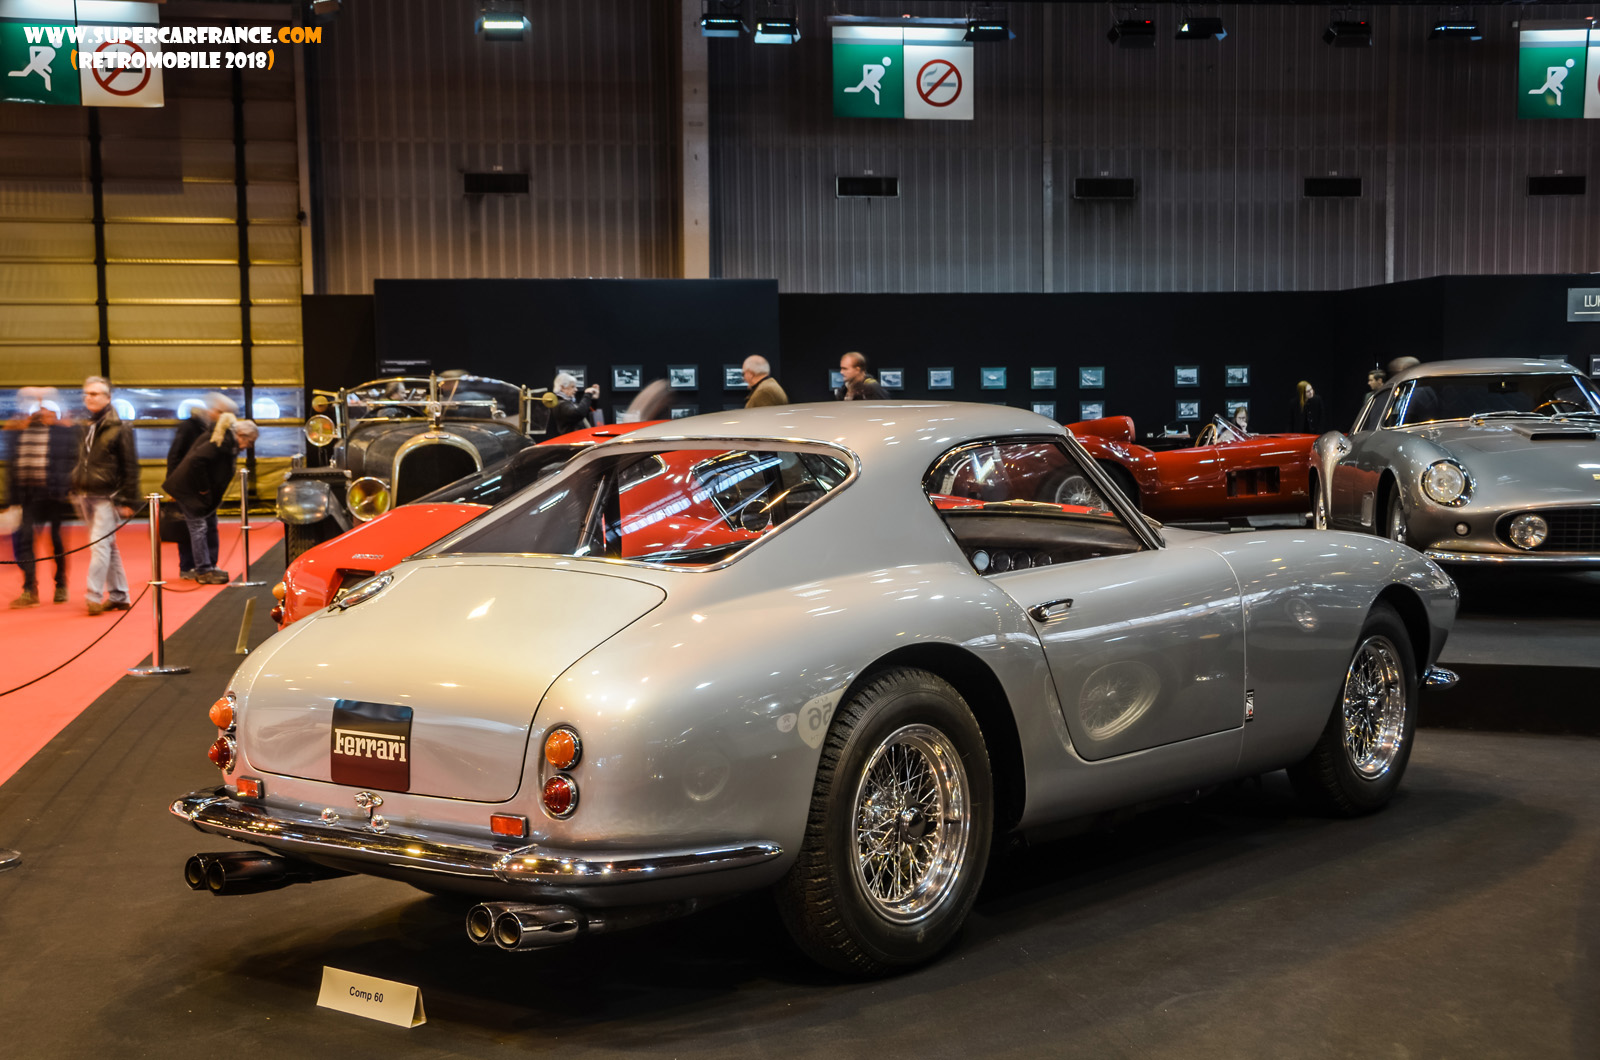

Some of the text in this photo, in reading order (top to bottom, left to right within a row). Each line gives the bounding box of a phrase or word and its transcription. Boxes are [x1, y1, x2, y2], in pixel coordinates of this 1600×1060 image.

[333, 728, 407, 762] Ferrari
[349, 986, 384, 1003] Comp 60
